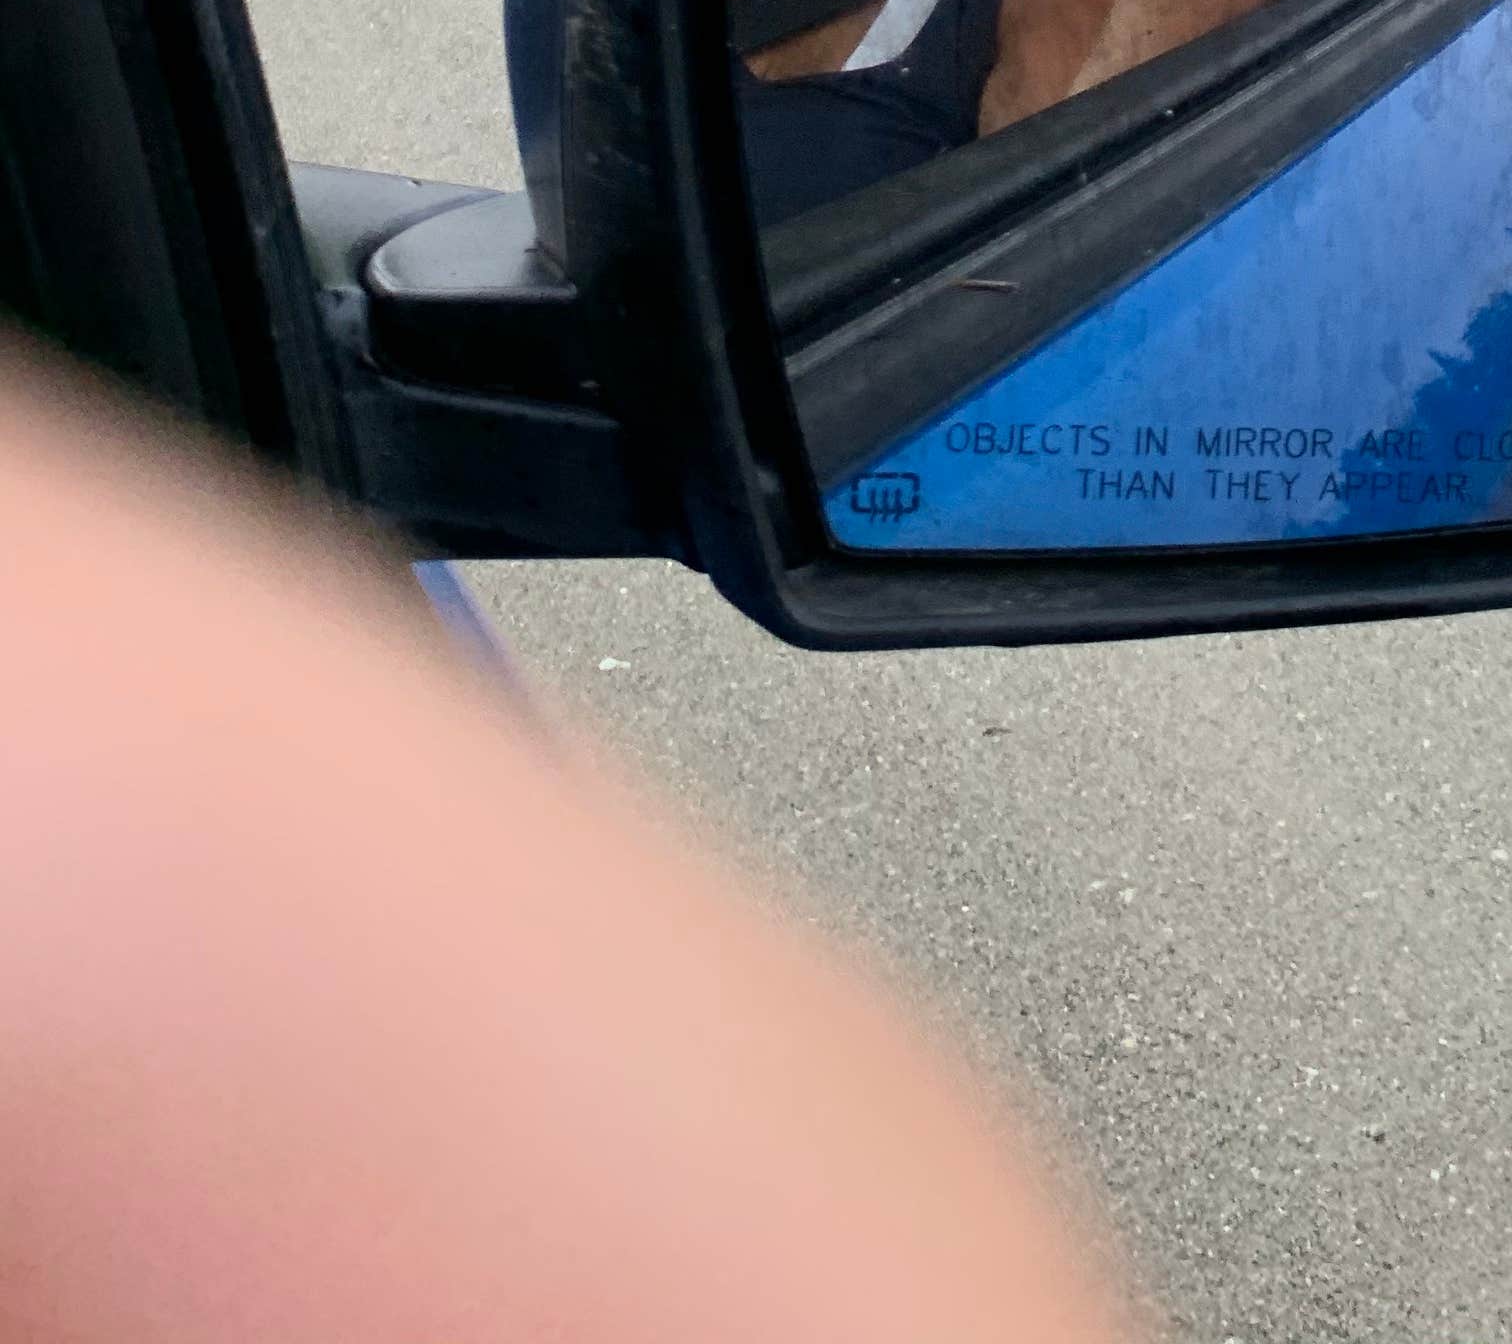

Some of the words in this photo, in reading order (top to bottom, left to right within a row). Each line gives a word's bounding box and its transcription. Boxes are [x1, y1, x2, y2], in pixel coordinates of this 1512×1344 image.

[946, 422, 1110, 456] OBJECTS
[1134, 426, 1168, 456] IN
[1197, 427, 1334, 458] MIRROR
[1359, 428, 1425, 460] ARE
[1076, 468, 1175, 500] THAN
[1205, 469, 1300, 502] THEY
[1319, 470, 1471, 504] APPEAR
